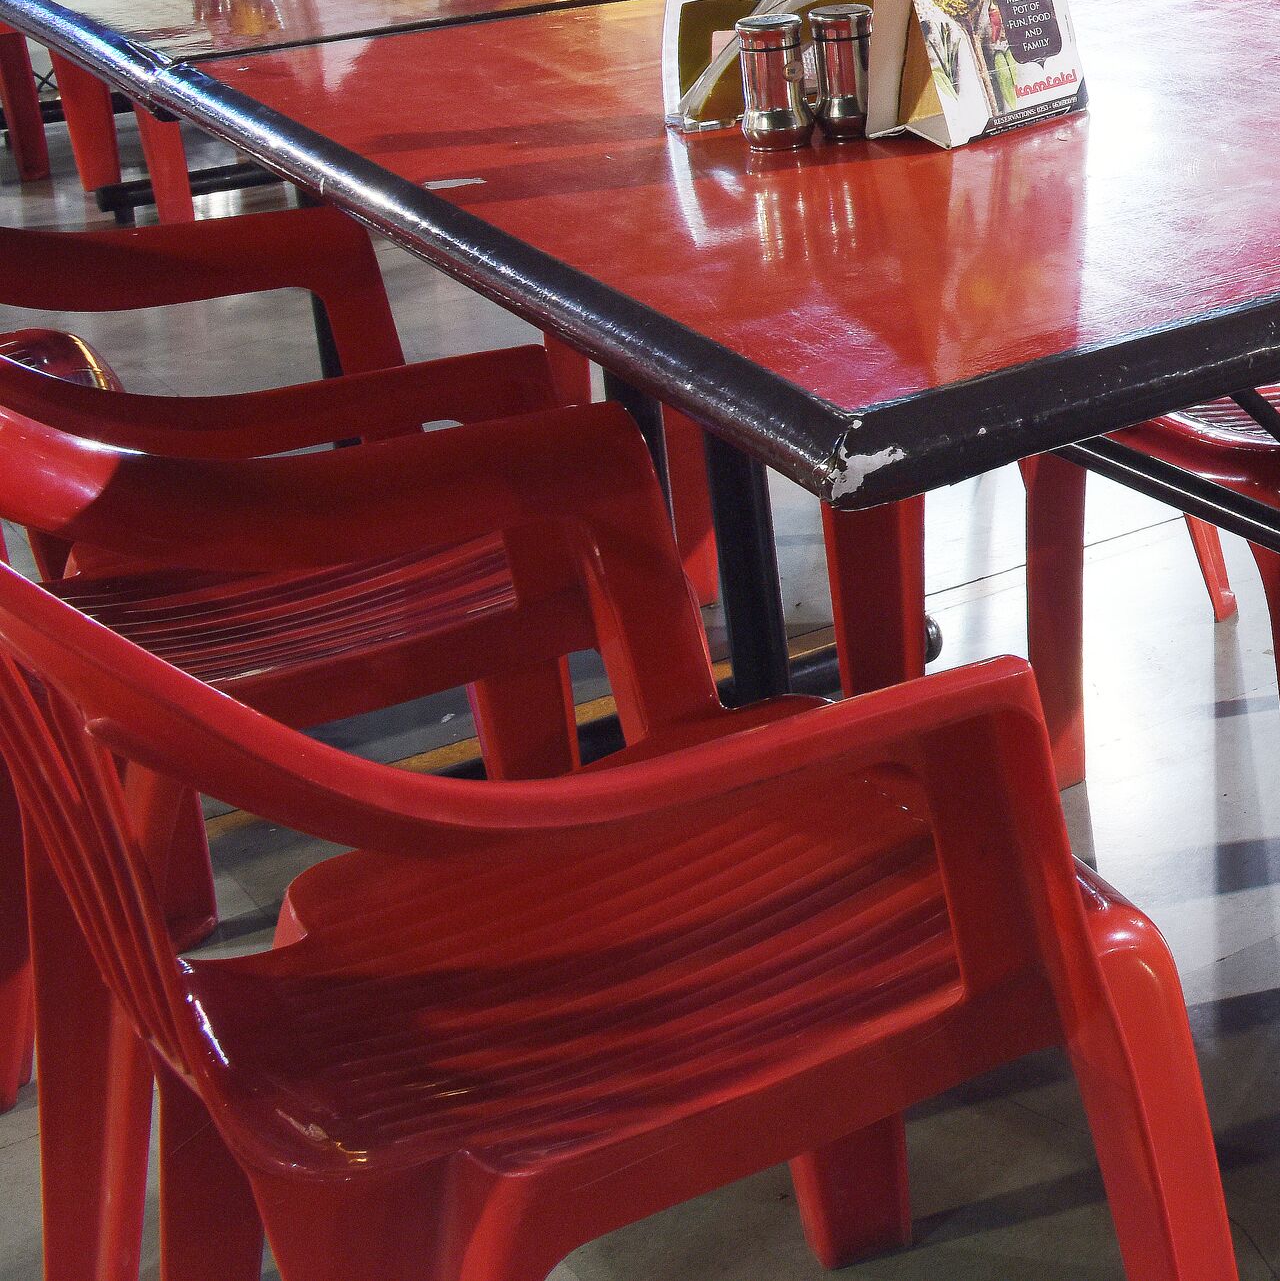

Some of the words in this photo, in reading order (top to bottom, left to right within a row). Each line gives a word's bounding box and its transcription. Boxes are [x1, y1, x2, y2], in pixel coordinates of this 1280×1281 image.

[1012, 4, 1028, 15] POT
[1029, 1, 1040, 11] OF
[1028, 12, 1051, 24] FOOD
[1025, 27, 1043, 39] AND
[1022, 37, 1050, 52] FAMILY
